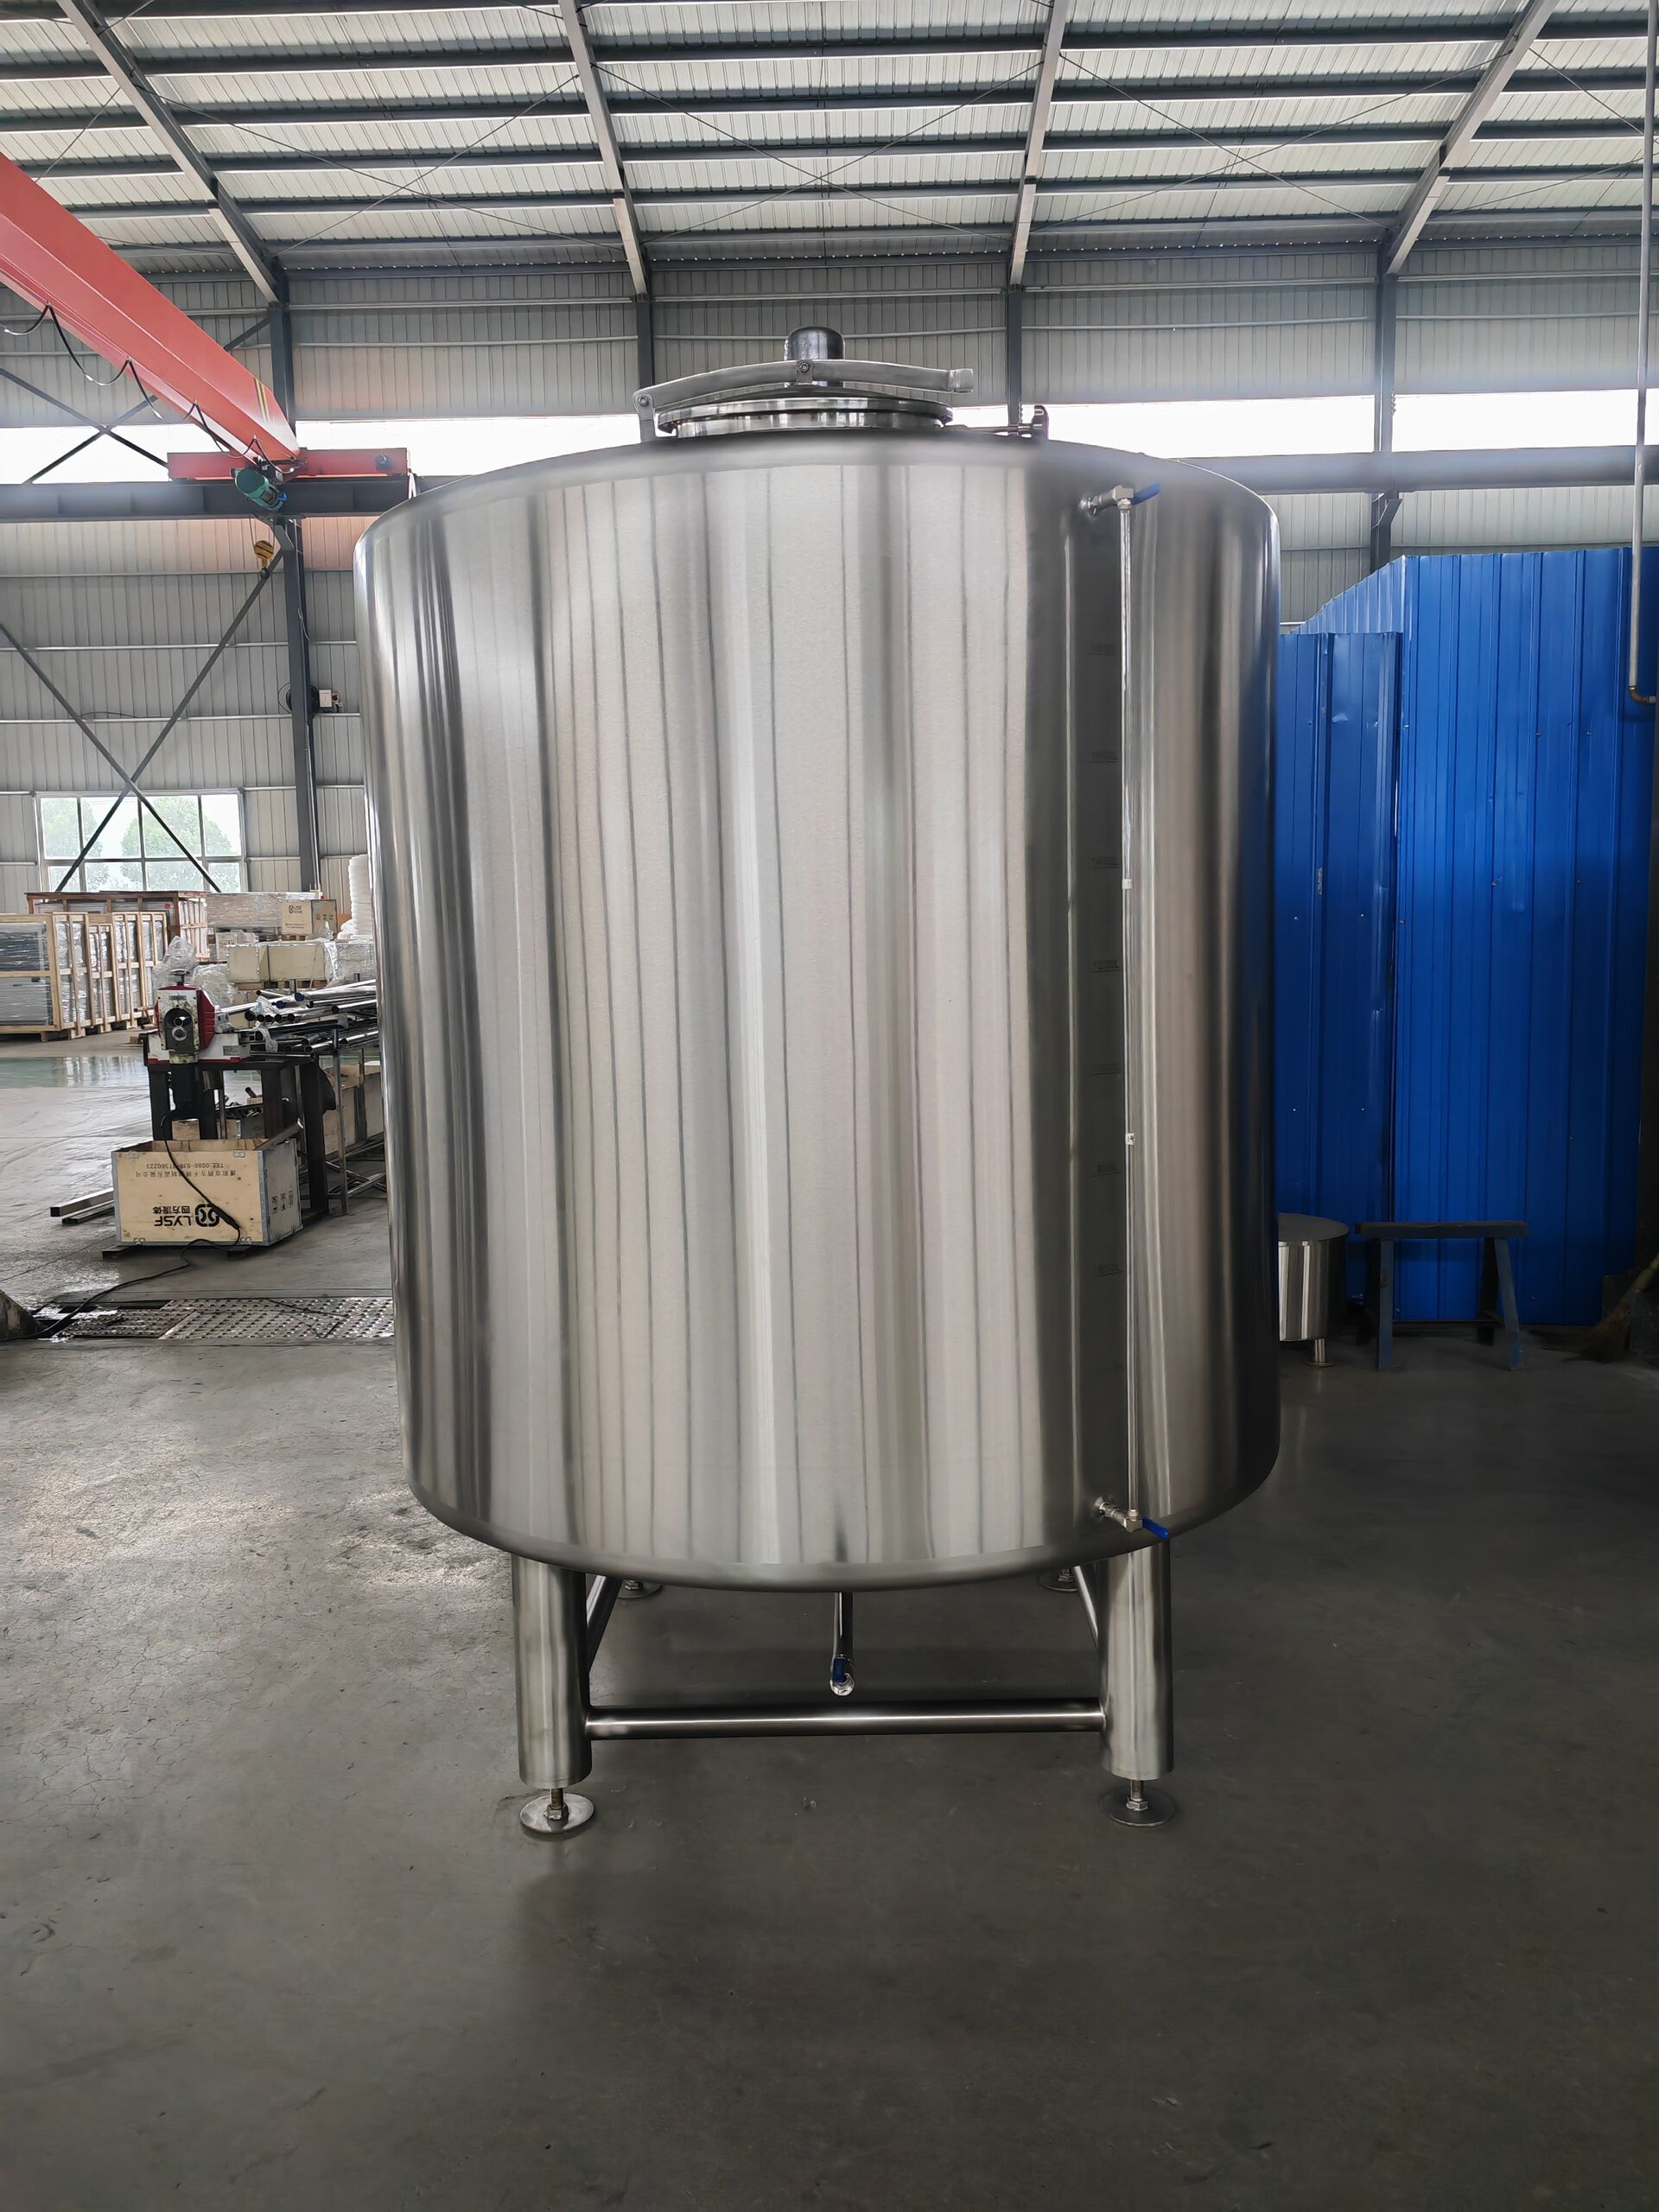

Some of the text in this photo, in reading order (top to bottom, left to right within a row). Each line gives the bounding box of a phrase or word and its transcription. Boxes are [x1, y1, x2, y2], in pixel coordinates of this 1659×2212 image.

[152, 1205, 191, 1215] 四方流体
[154, 1215, 192, 1226] LYSF
